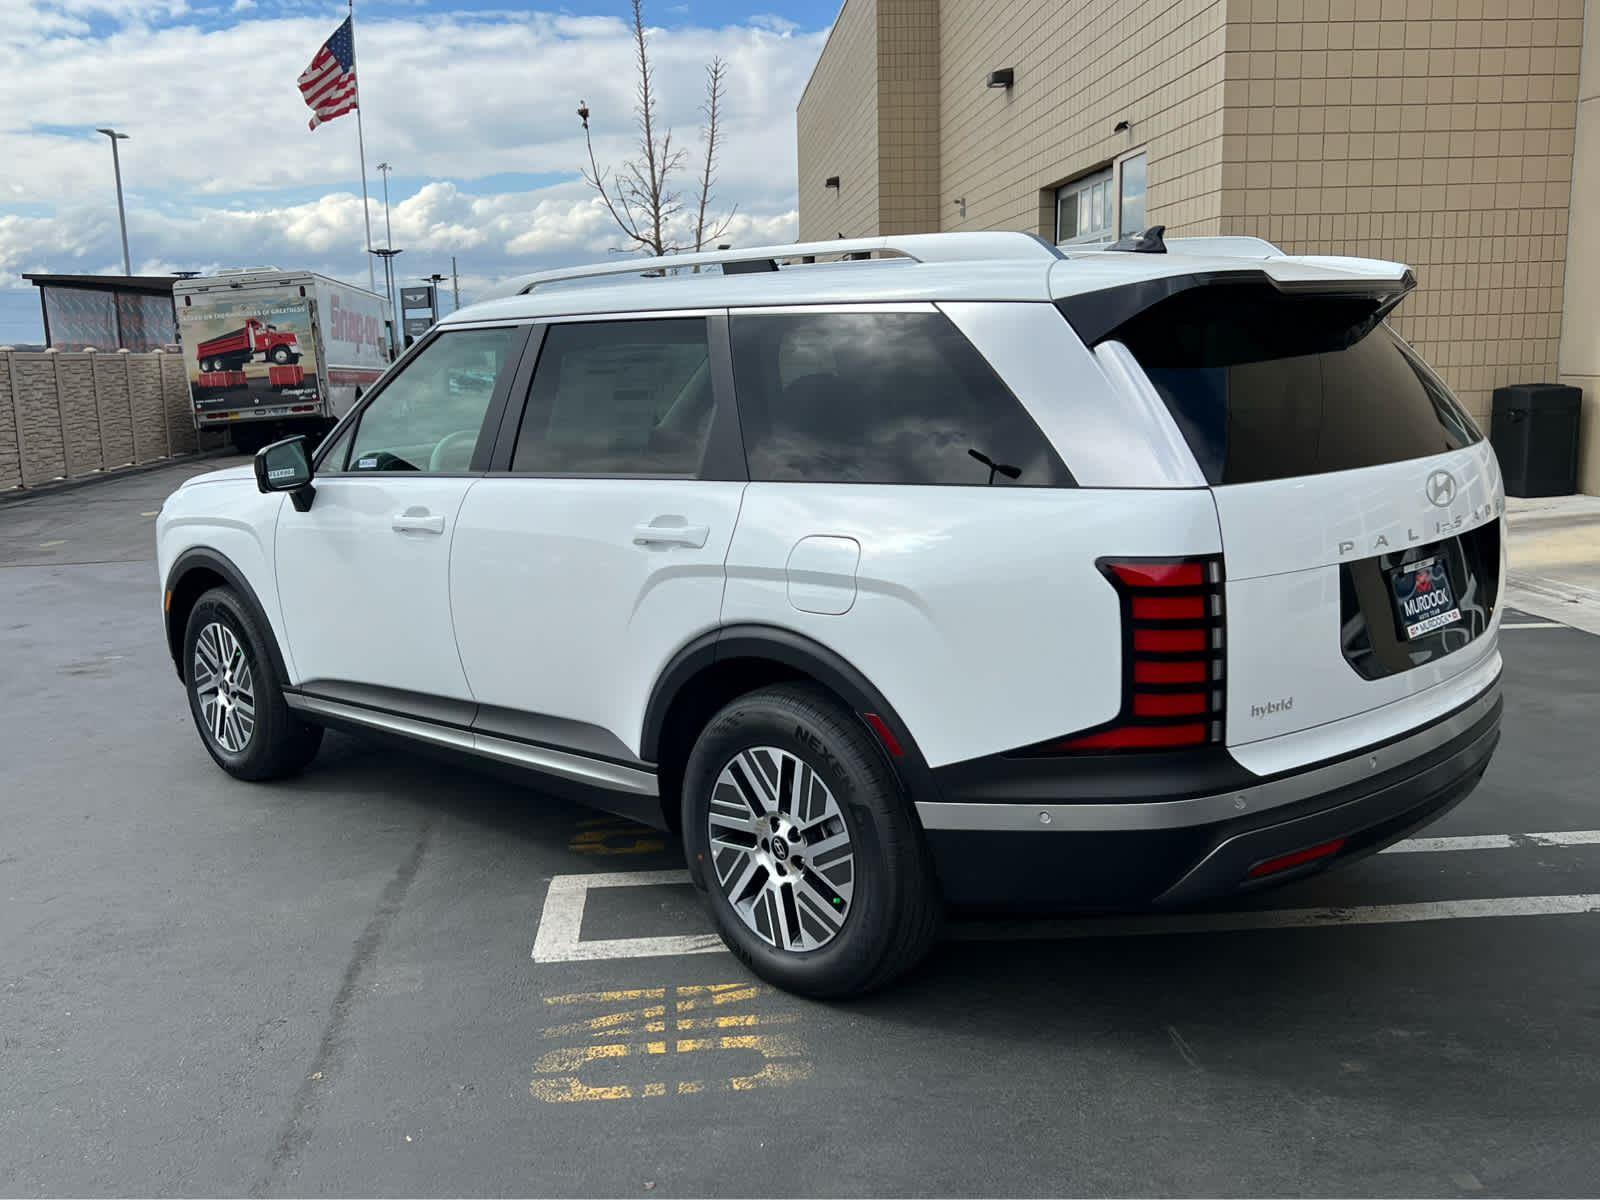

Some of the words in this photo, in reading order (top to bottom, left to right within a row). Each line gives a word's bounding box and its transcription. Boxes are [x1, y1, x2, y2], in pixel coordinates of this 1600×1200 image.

[331, 295, 380, 353] Snap-on
[1404, 588, 1449, 616] MURDOCK
[1419, 615, 1449, 631] MURDOCK
[1251, 696, 1293, 720] hybrid
